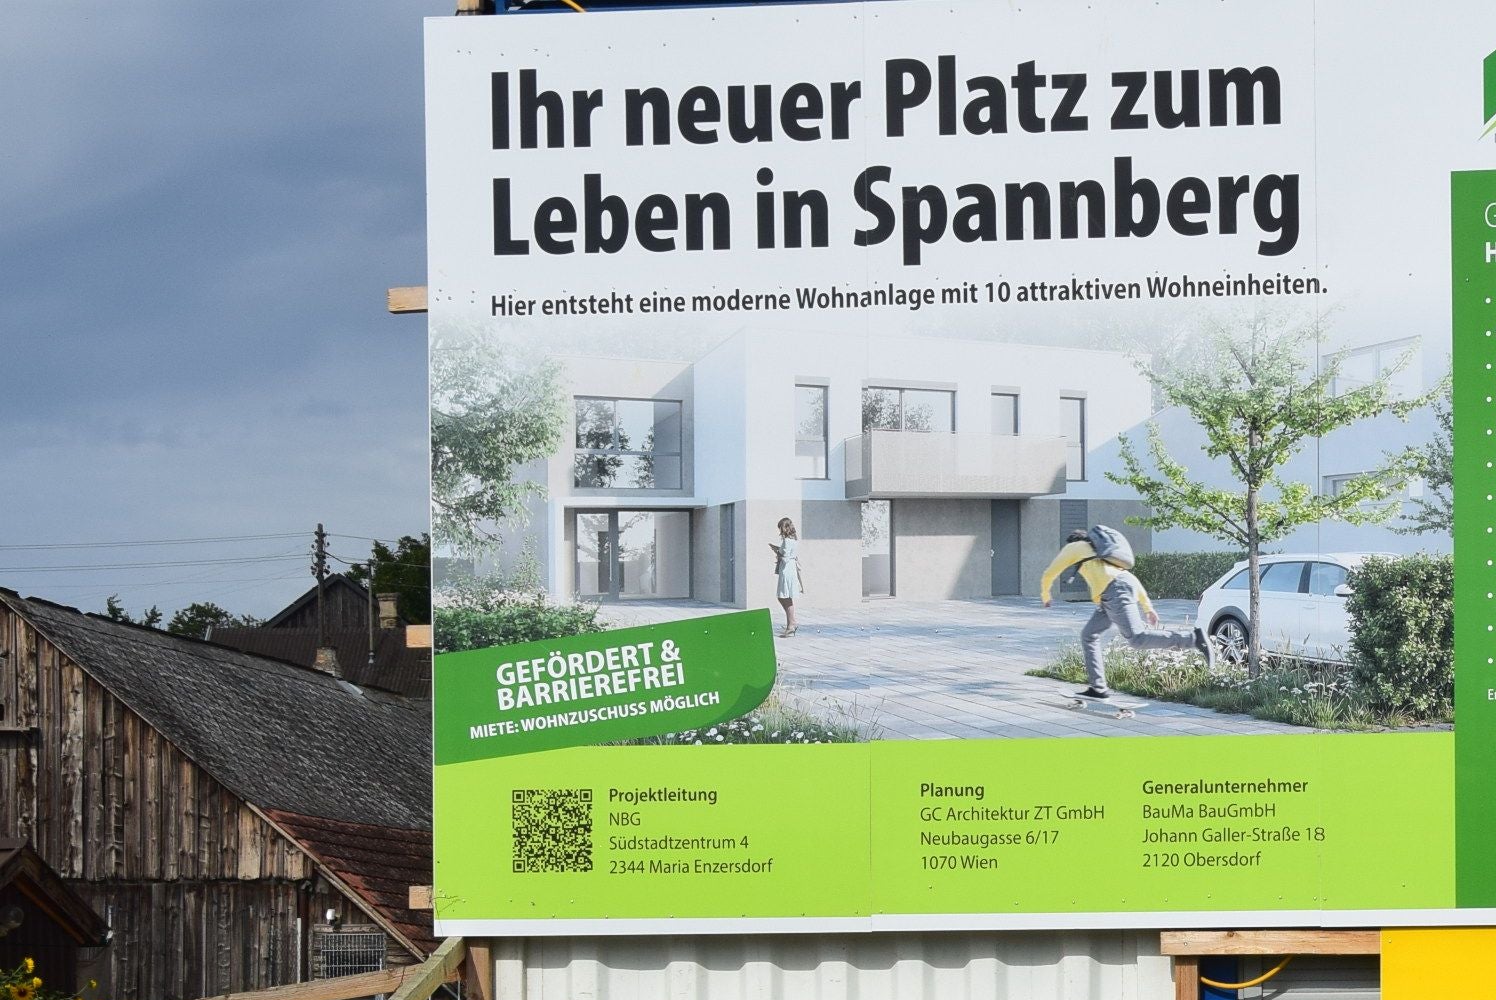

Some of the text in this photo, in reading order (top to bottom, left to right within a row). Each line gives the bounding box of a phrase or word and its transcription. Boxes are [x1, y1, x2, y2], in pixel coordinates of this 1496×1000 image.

[491, 54, 1282, 150] Ihr neuer Platz zum
[492, 156, 1300, 264] Leben in Spannberg
[491, 272, 1328, 317] Hier entsteht eine moderne Wohnanlage mit 10 attraktiven Wohneinheiten.
[496, 639, 682, 686] GEFÖRDERT &
[497, 662, 685, 711] BARRIEREFREI
[469, 690, 721, 740] MIETE: WOHNZUSCHUSS MÖGLICH
[920, 782, 985, 801] Planung
[1142, 778, 1309, 795] Generalunternehmer
[609, 787, 718, 806] Projektleitung
[609, 811, 641, 827] NBG
[920, 804, 1105, 822] GC Architektur ZT GmbH
[1142, 802, 1276, 819] BauMa BauGmbH
[609, 835, 749, 851] Südstadtzentrum 4
[920, 829, 1060, 849] Neubaugasse 6/17
[1141, 828, 1198, 843] Johann
[1201, 826, 1301, 843] Galler-Straße
[609, 857, 774, 875] 2344 Maria Enzersdorf
[921, 854, 998, 870] 1070 Wien
[1142, 850, 1262, 868] 2120 Obersdorf
